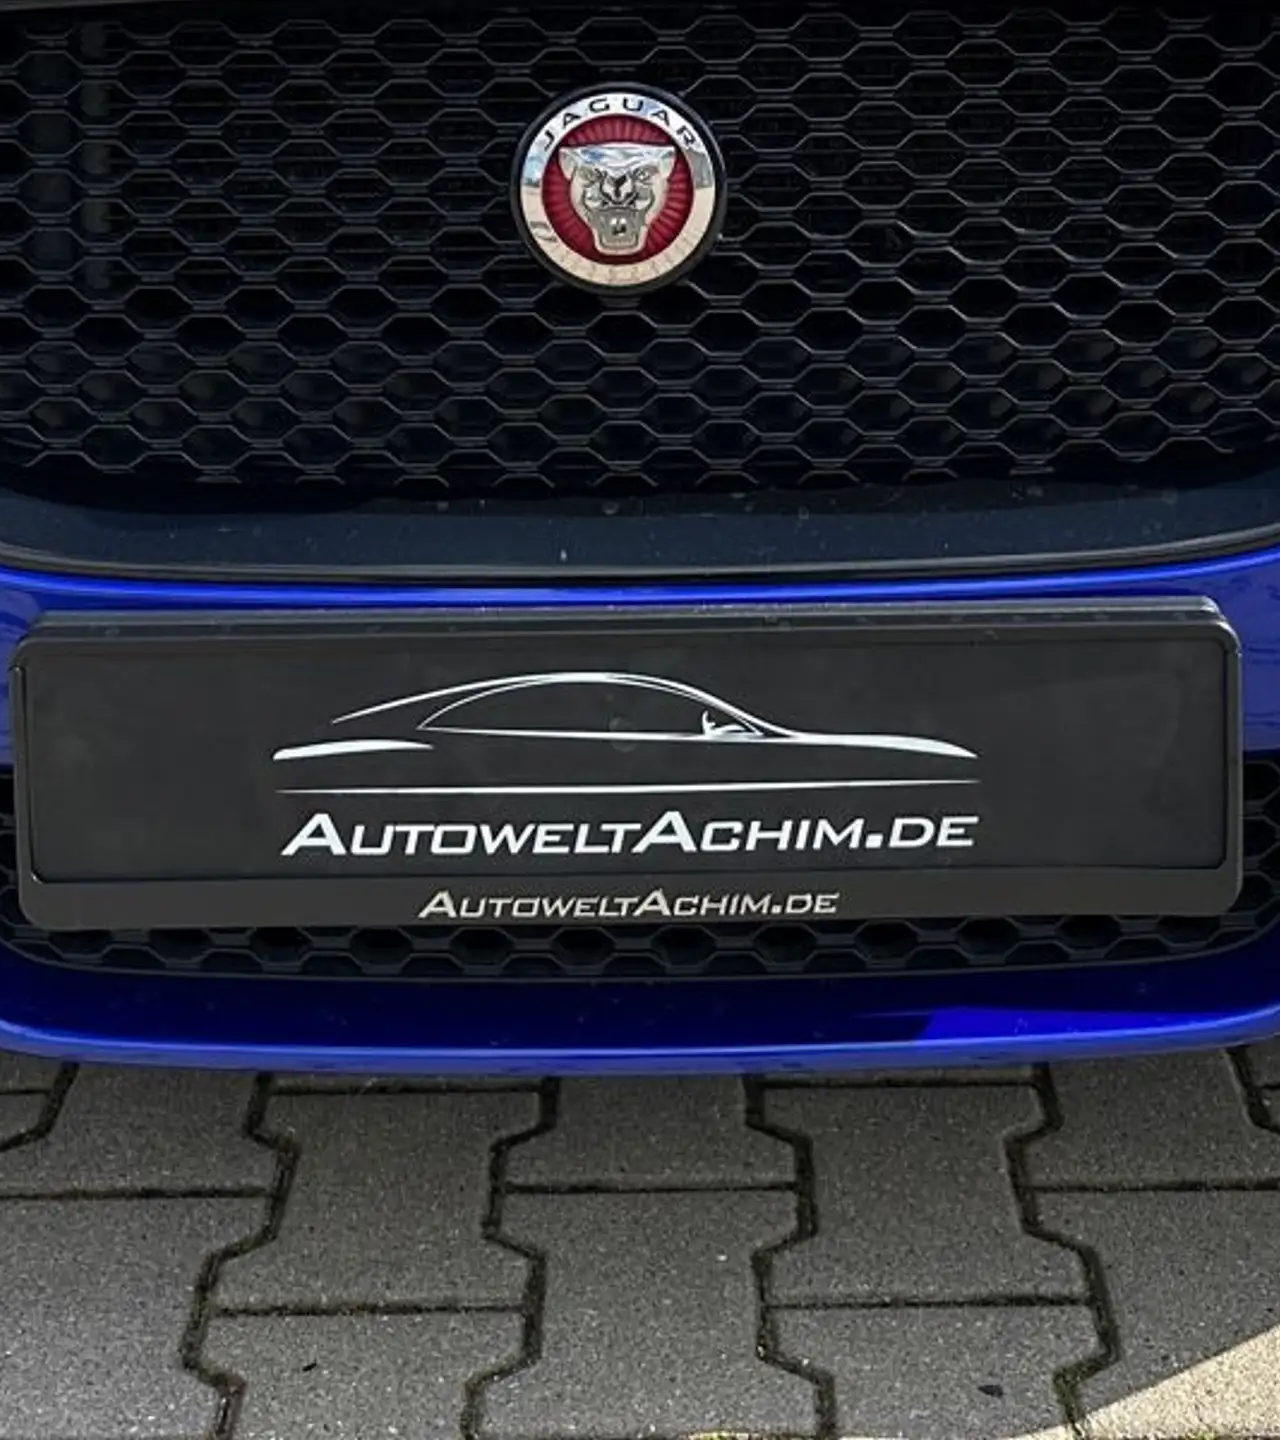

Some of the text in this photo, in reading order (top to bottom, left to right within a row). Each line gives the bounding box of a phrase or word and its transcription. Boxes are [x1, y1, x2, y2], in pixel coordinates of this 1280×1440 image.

[541, 96, 697, 153] JAGUAR
[280, 811, 980, 856] AUTOWELTACHIM.DE
[417, 889, 840, 919] AUTOWELTACHIM.DE
